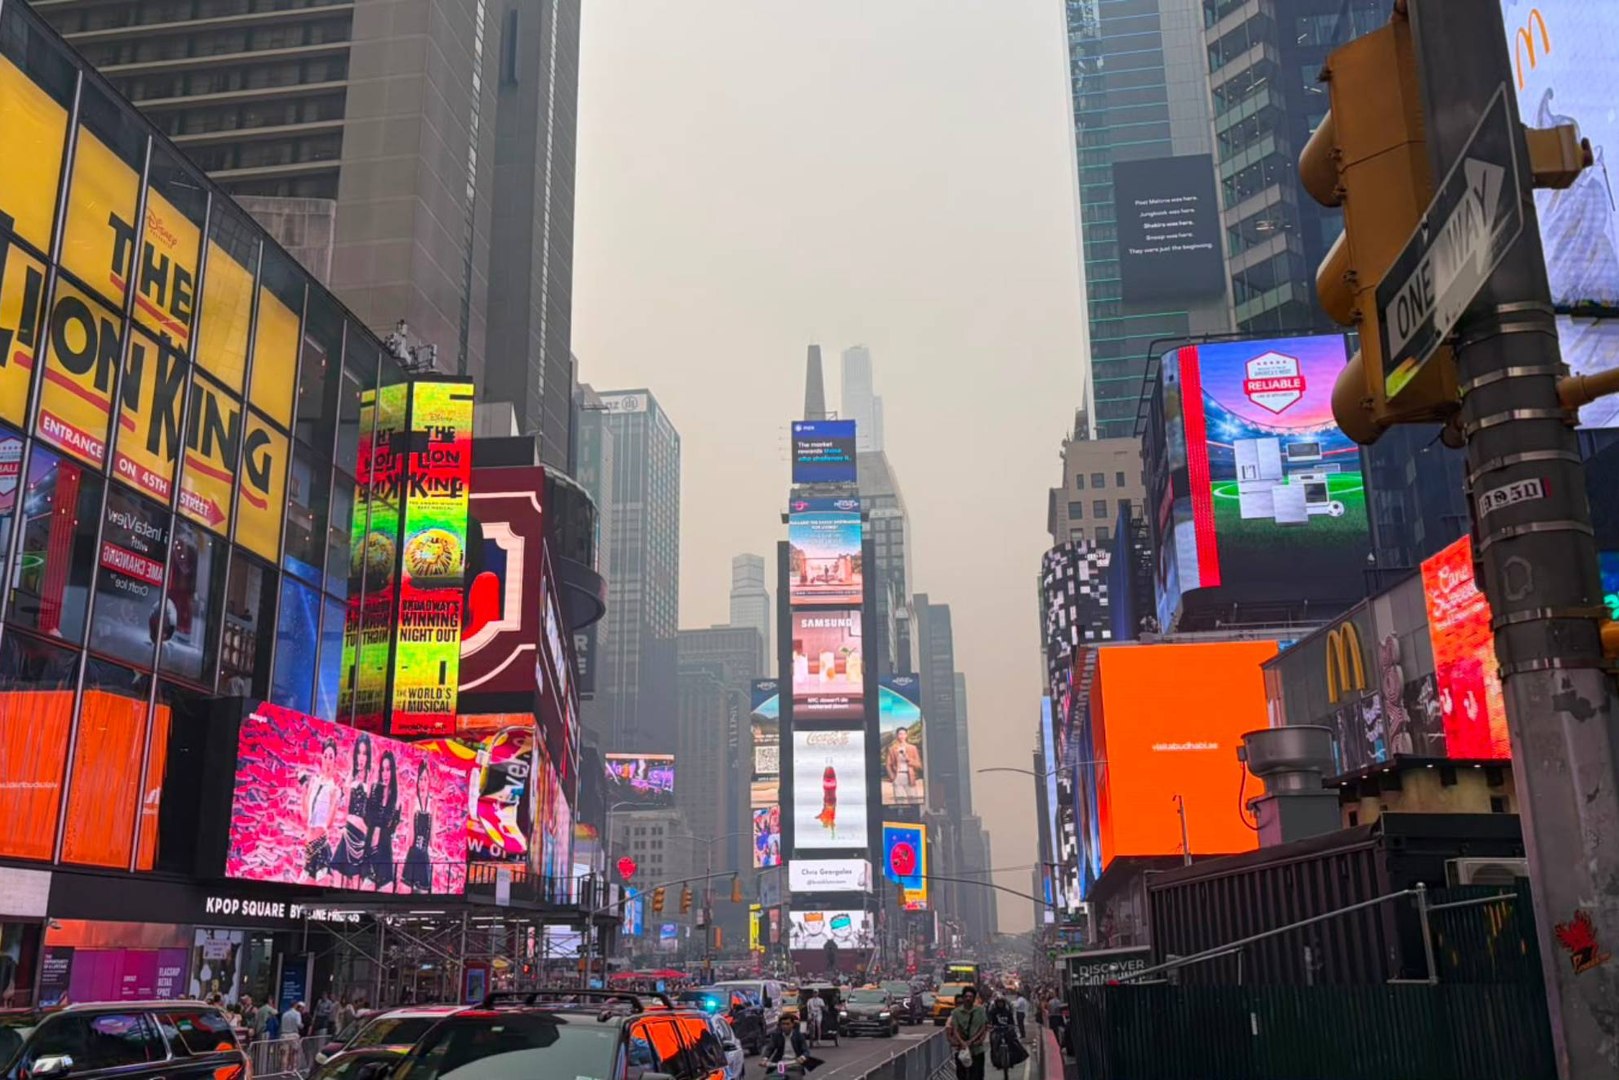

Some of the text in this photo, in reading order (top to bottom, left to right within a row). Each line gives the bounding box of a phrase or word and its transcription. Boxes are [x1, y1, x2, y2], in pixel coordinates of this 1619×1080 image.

[146, 207, 178, 249] Disney
[1396, 168, 1496, 341] ONE WAY
[108, 211, 193, 326] THE
[1248, 378, 1301, 390] RELIABLE
[145, 331, 272, 495] KING
[425, 425, 456, 443] THE
[42, 415, 210, 516] ENTRANCE ON 45TH STREET
[418, 449, 461, 470] LION
[410, 473, 463, 498] KING
[402, 613, 459, 628] WINNING
[801, 618, 853, 629] SAMSUNG
[400, 628, 458, 643] NIGHT OUT
[408, 688, 452, 700] WORLD'S
[407, 700, 451, 714] MUSICAL
[206, 897, 239, 915] KPOP
[241, 900, 285, 918] SQUARE
[289, 904, 302, 919] BY
[1079, 959, 1145, 976] DISCOVER
